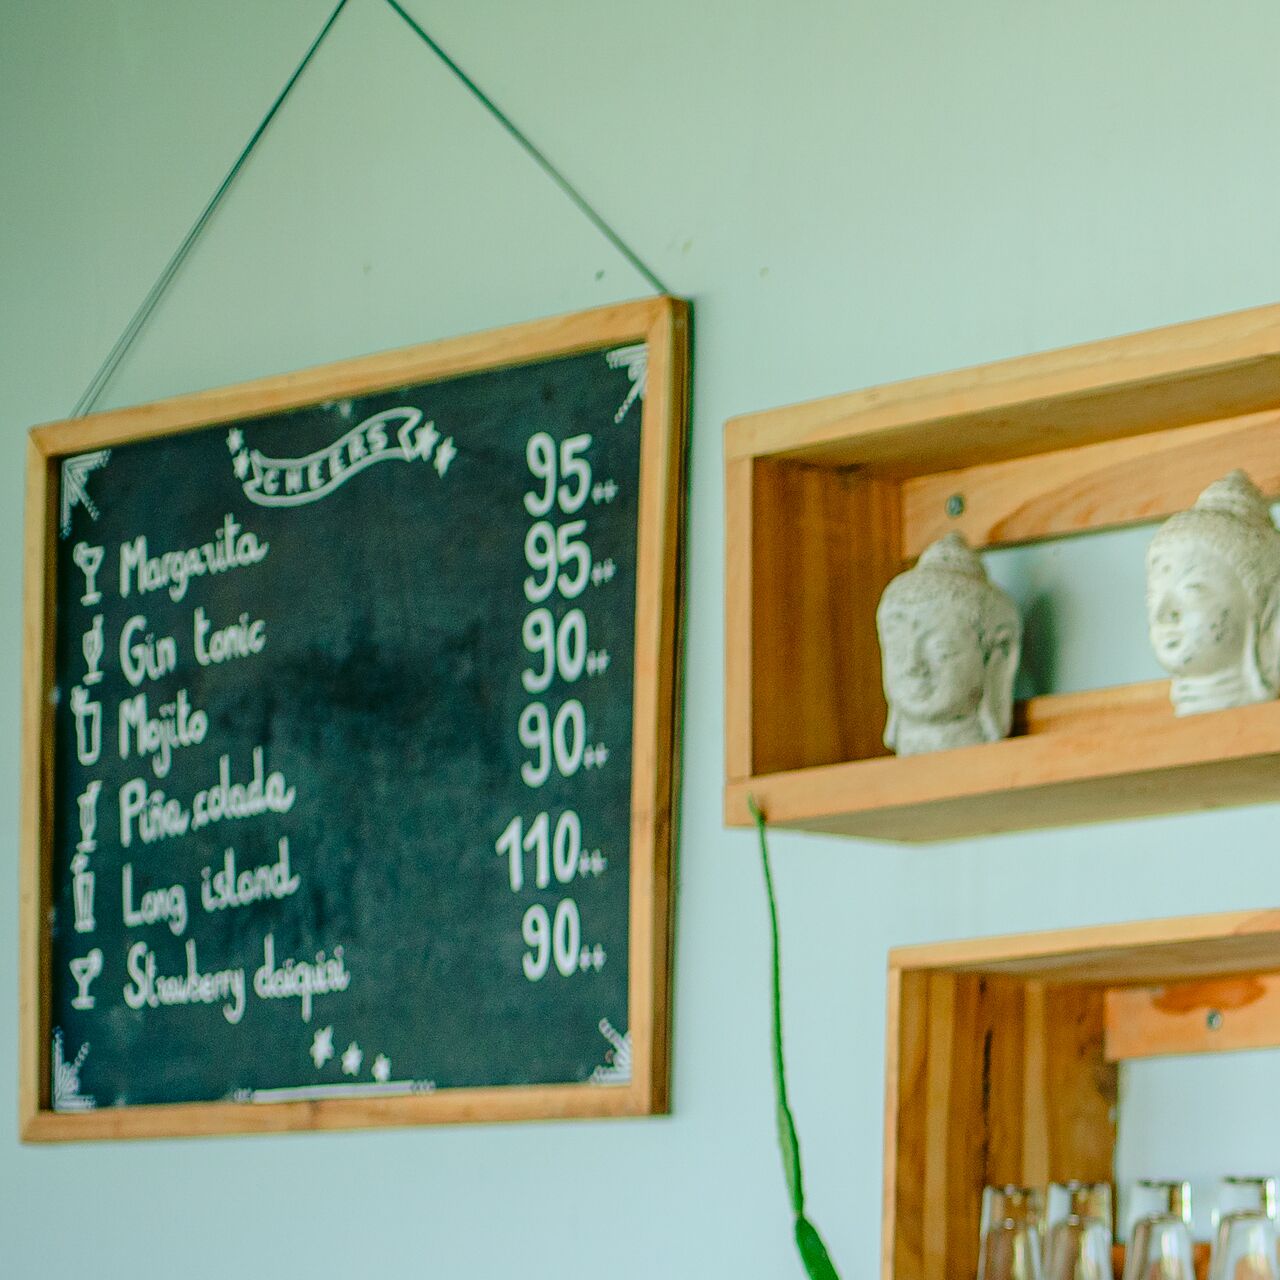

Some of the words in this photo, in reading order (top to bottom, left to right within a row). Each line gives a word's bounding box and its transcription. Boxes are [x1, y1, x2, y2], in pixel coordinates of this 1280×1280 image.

[262, 420, 388, 496] CHEERS
[119, 512, 270, 602] Margarita
[119, 614, 177, 686] Gin
[193, 606, 266, 666] tonic
[118, 688, 209, 778] Mojito
[191, 745, 296, 831] colada
[122, 862, 188, 936] Long
[200, 835, 301, 913] island
